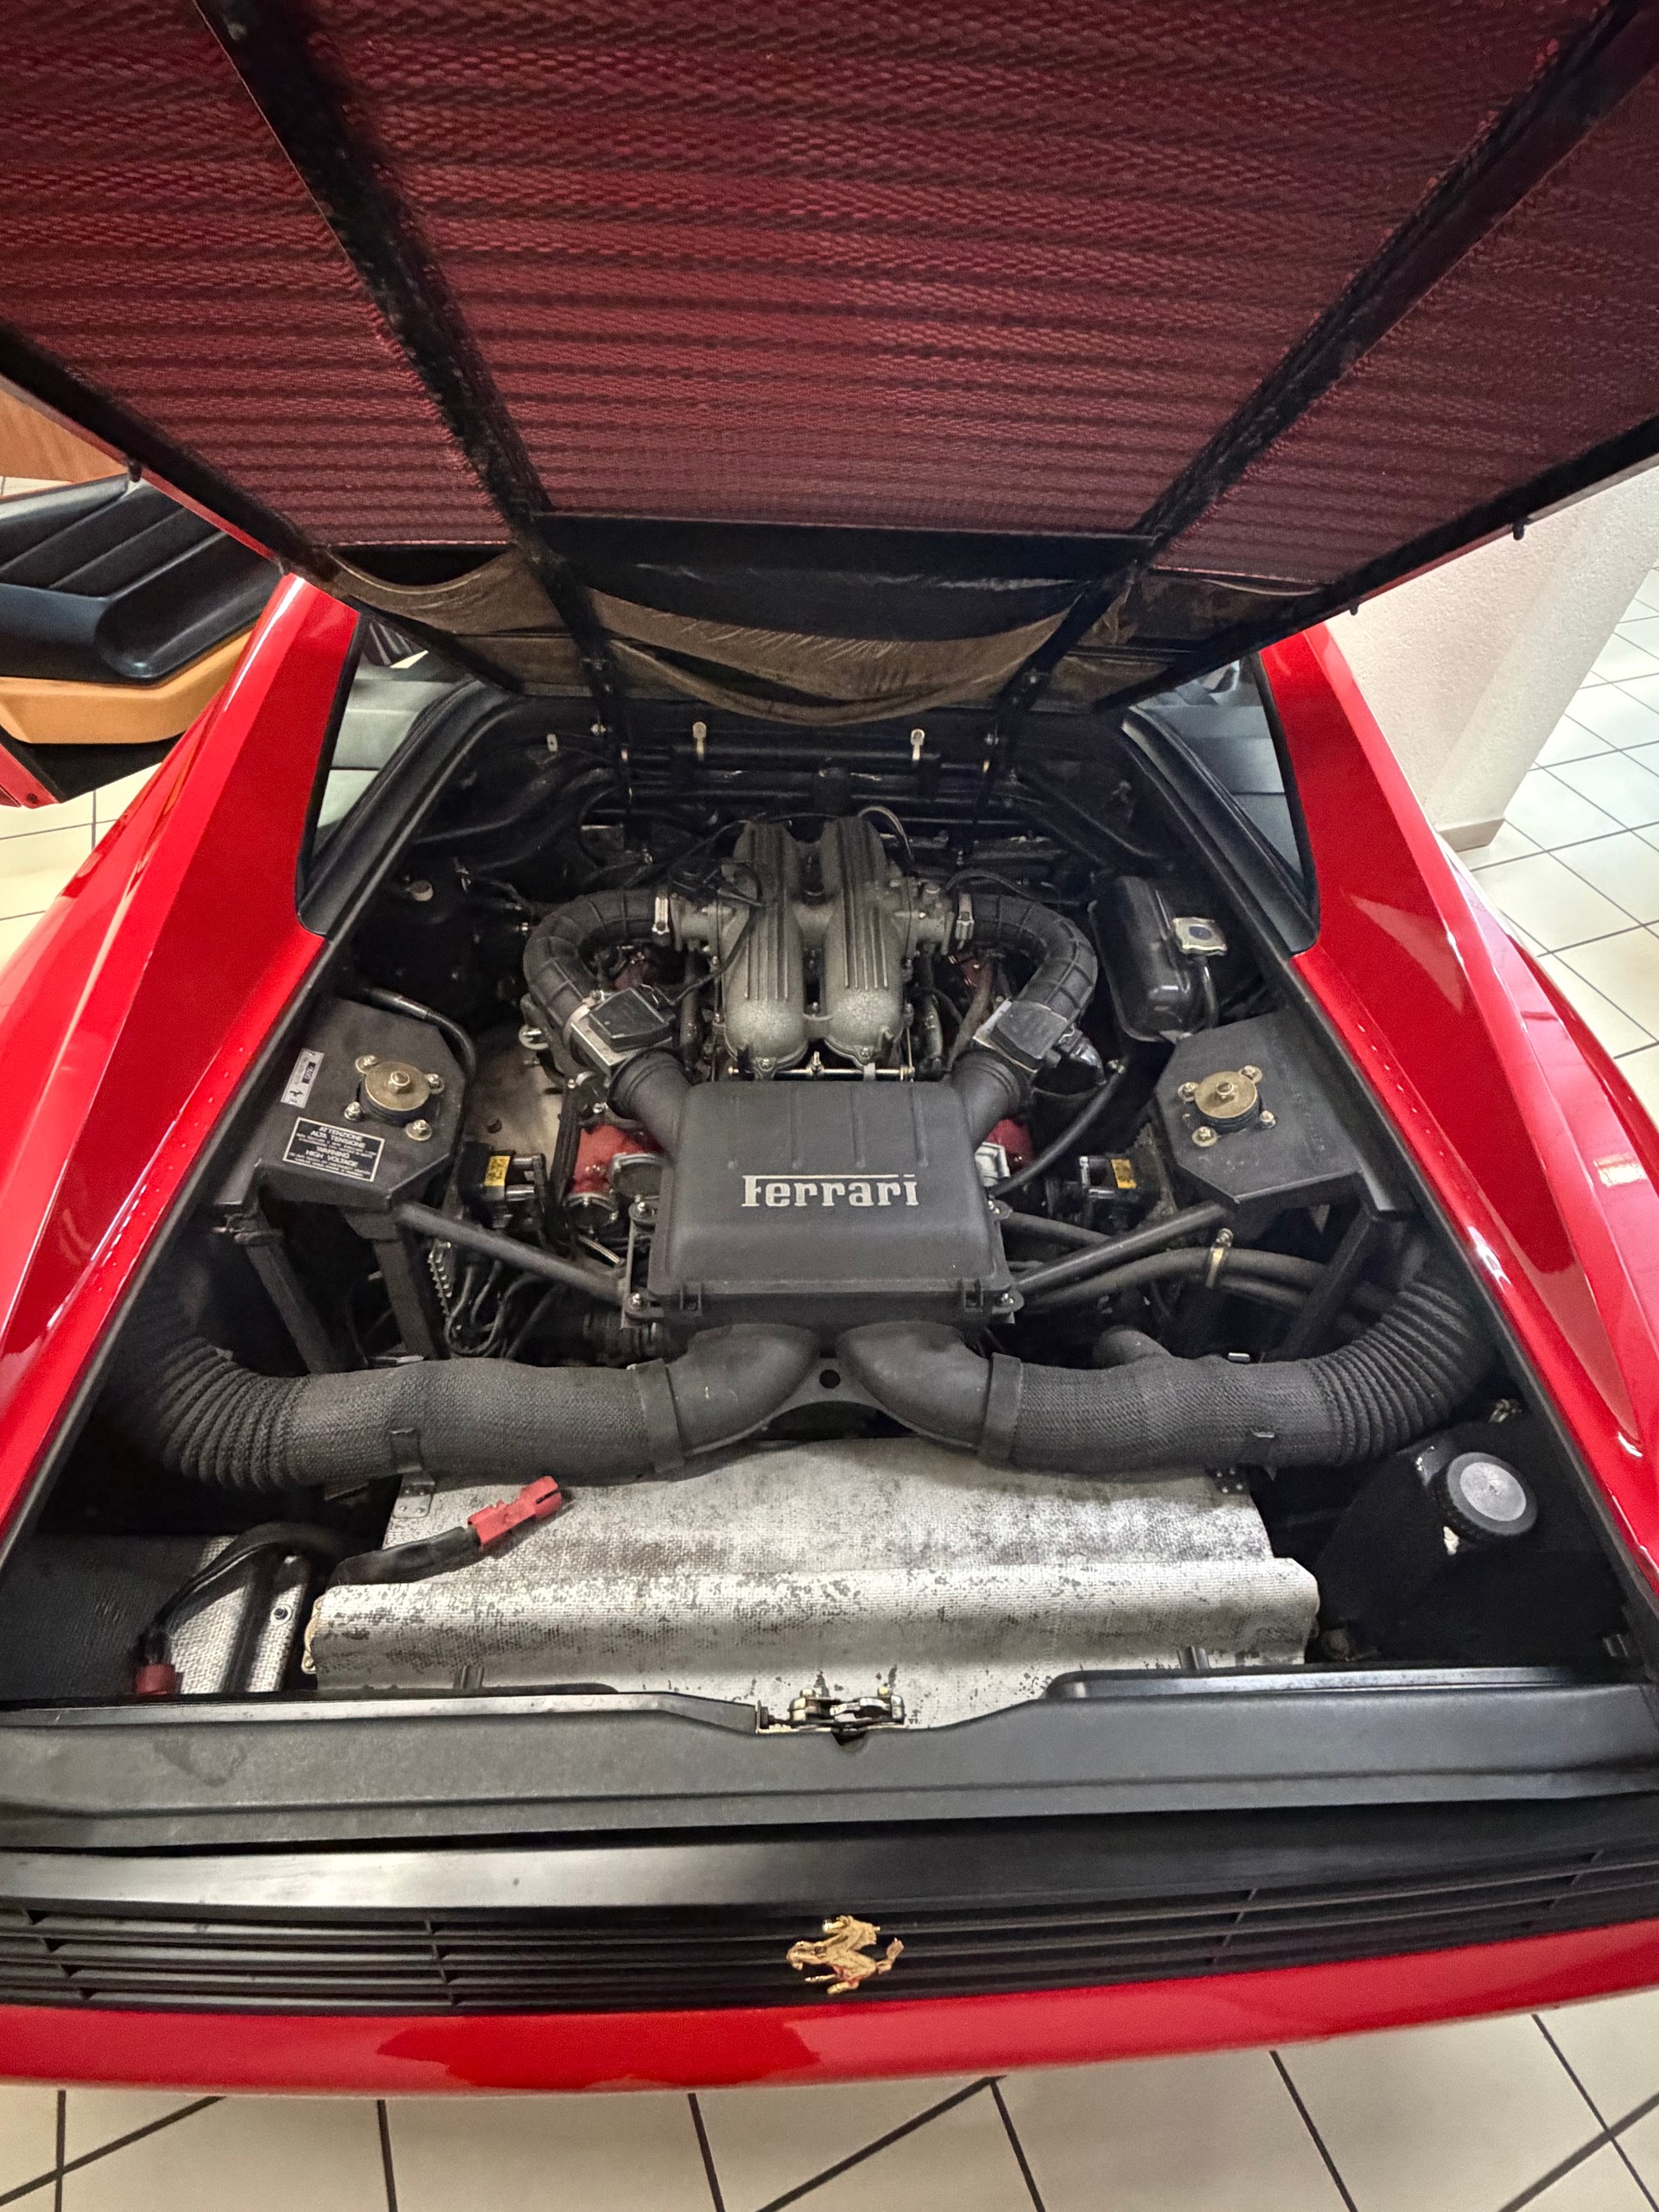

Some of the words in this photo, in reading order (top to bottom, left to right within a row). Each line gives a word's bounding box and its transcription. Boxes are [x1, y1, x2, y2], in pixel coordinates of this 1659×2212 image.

[310, 1130, 327, 1139] ALTA
[330, 1135, 366, 1148] TENSIONE
[319, 1126, 363, 1141] ATTENZIONE
[305, 1149, 324, 1159] HIGH
[327, 1154, 359, 1167] VOLTAGE
[316, 1146, 351, 1159] WARNING
[741, 1174, 918, 1207] Ferrari
